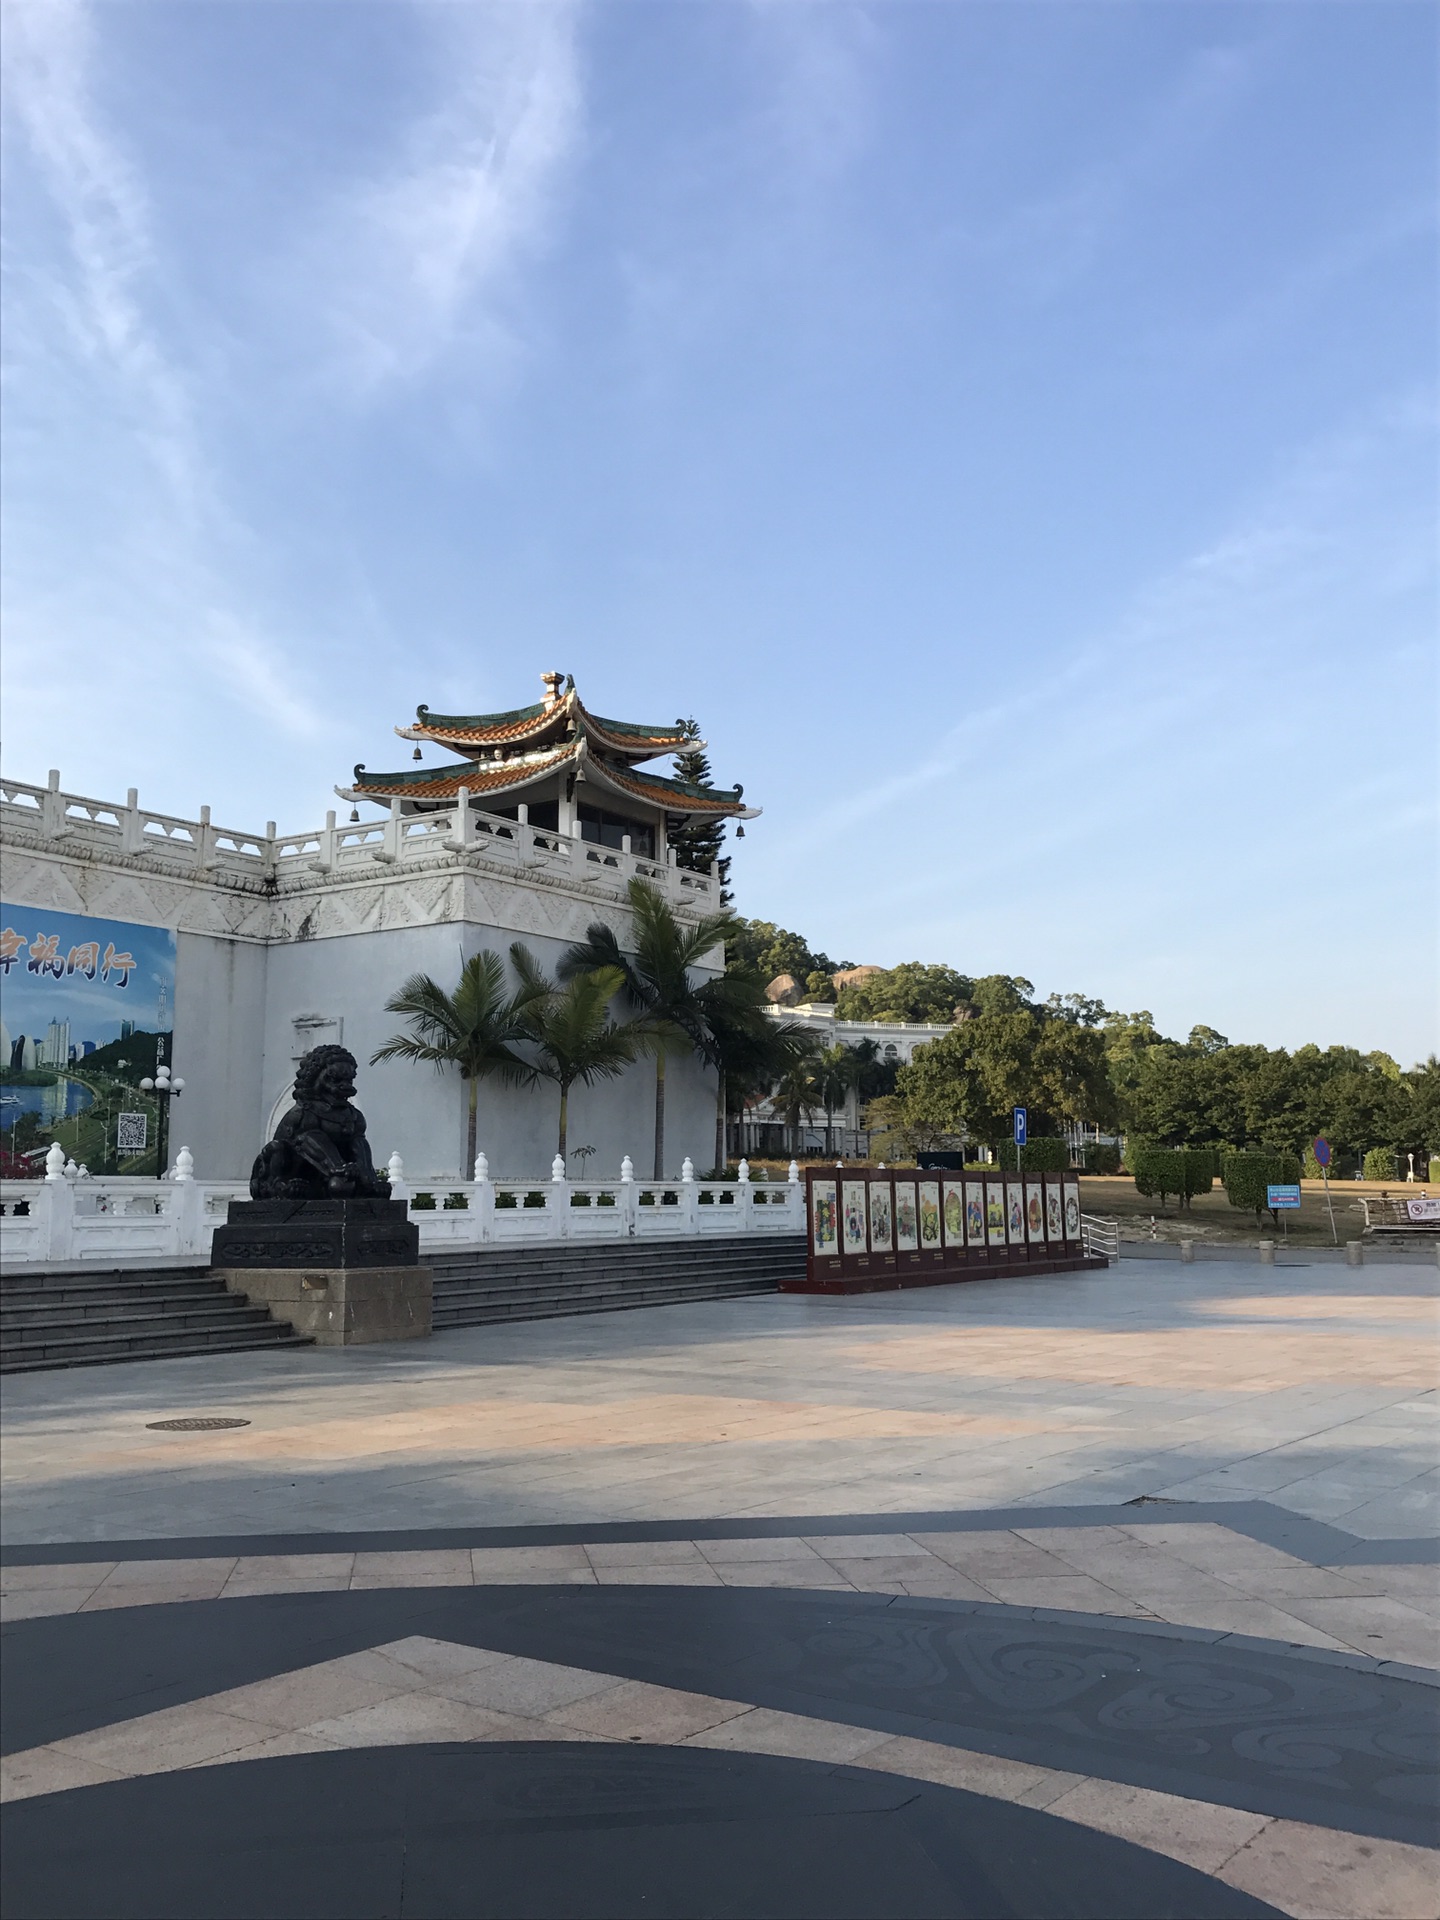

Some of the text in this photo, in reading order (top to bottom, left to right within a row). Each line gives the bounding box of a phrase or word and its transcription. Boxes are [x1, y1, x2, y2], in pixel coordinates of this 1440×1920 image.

[0, 928, 137, 989] 幸福同行
[1017, 1113, 1025, 1140] P
